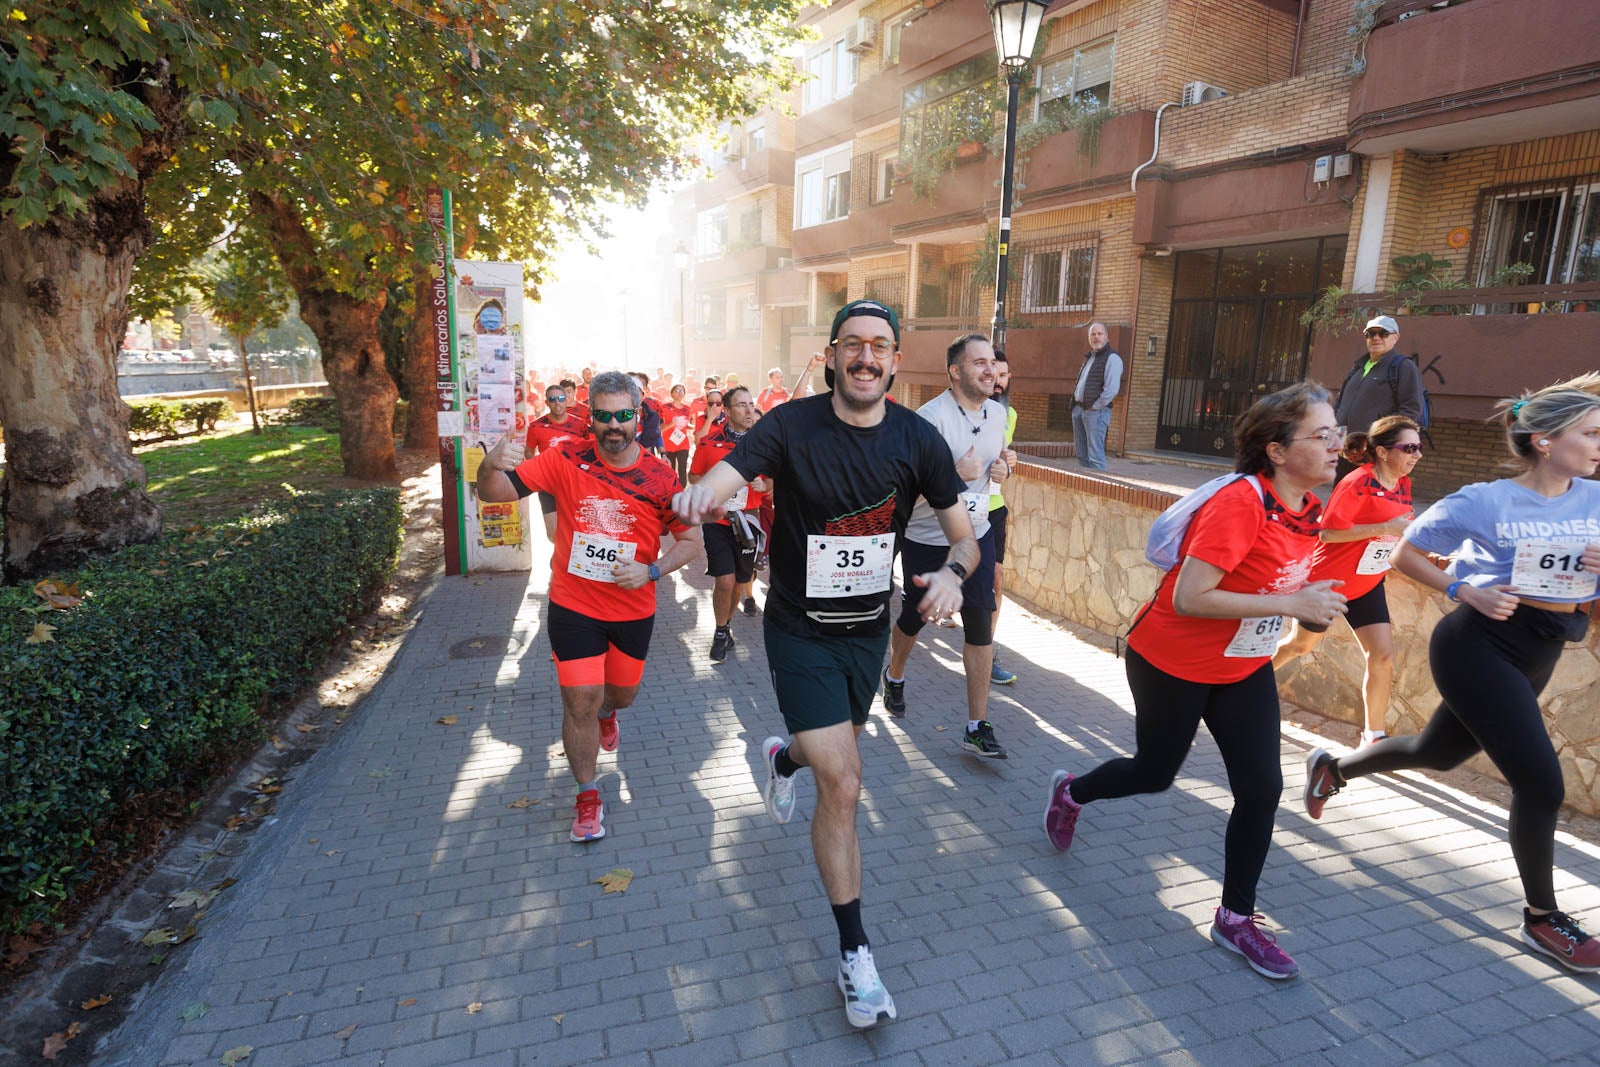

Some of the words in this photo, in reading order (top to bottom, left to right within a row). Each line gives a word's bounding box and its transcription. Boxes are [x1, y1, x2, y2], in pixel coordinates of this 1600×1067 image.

[1260, 279, 1267, 292] 2
[1496, 518, 1600, 539] KINDNES
[585, 545, 617, 562] 546
[836, 550, 865, 568] 35
[847, 569, 873, 577] MORALES
[1256, 615, 1283, 635] 619
